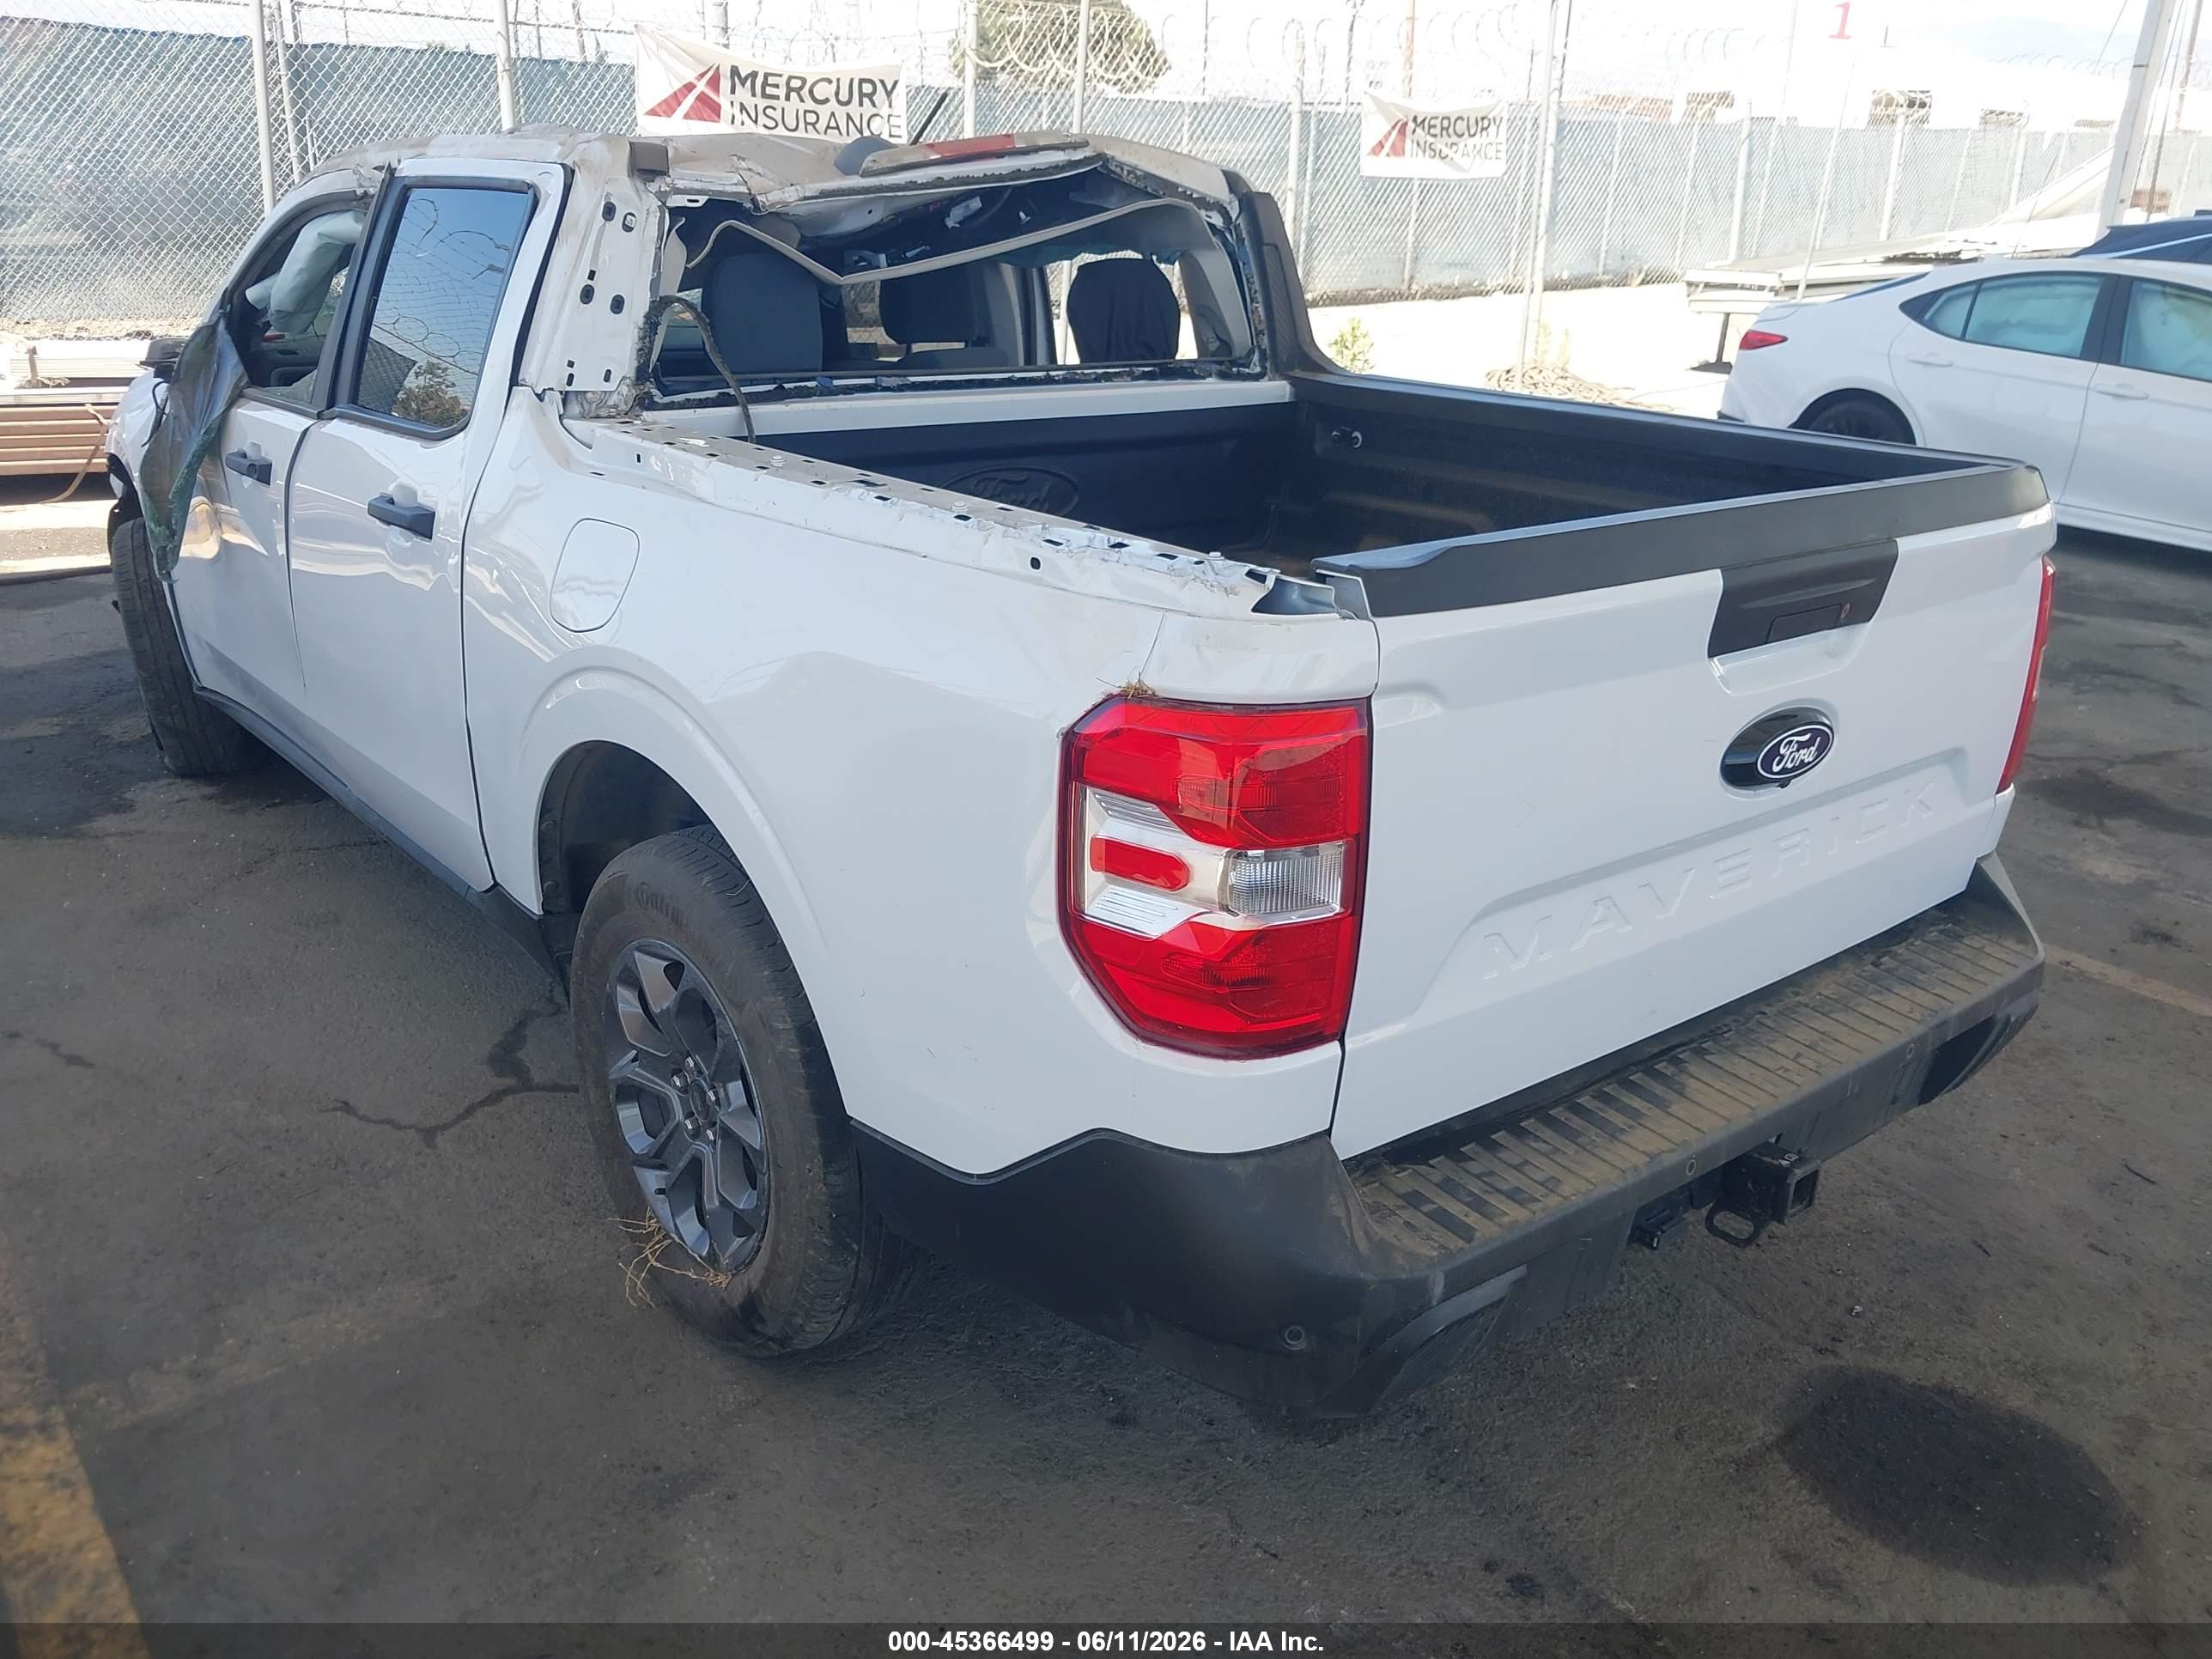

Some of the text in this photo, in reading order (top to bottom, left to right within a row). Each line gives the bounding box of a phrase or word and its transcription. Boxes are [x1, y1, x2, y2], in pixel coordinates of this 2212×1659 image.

[1828, 2, 1850, 39] 1
[729, 64, 900, 109] MERCURY
[730, 100, 902, 138] INSURANCE
[1411, 114, 1504, 138] MERCURY
[1771, 732, 1820, 772] Ford
[1482, 780, 1940, 981] MAVERICK
